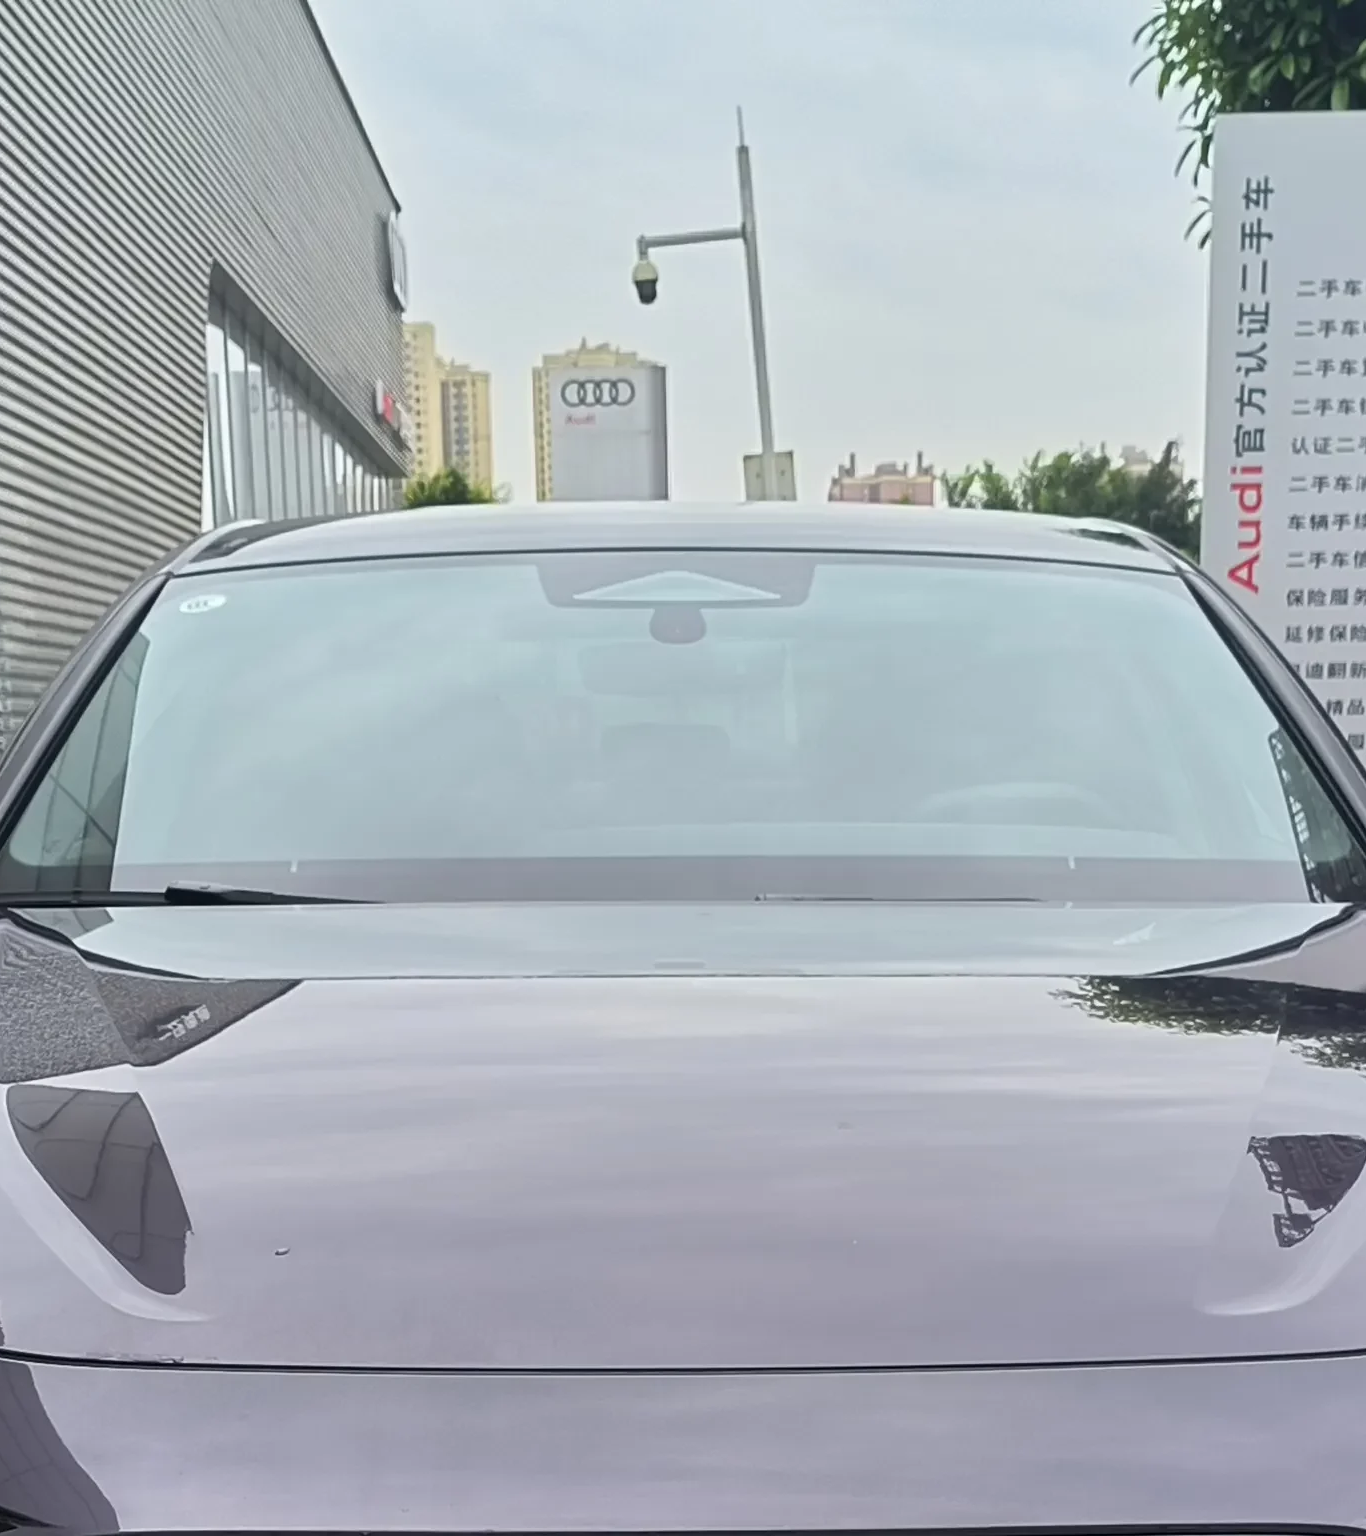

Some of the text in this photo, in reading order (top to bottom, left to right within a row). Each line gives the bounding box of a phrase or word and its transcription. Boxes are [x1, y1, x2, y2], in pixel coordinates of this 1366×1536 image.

[1227, 175, 1275, 594] Audi 官方认证二手车
